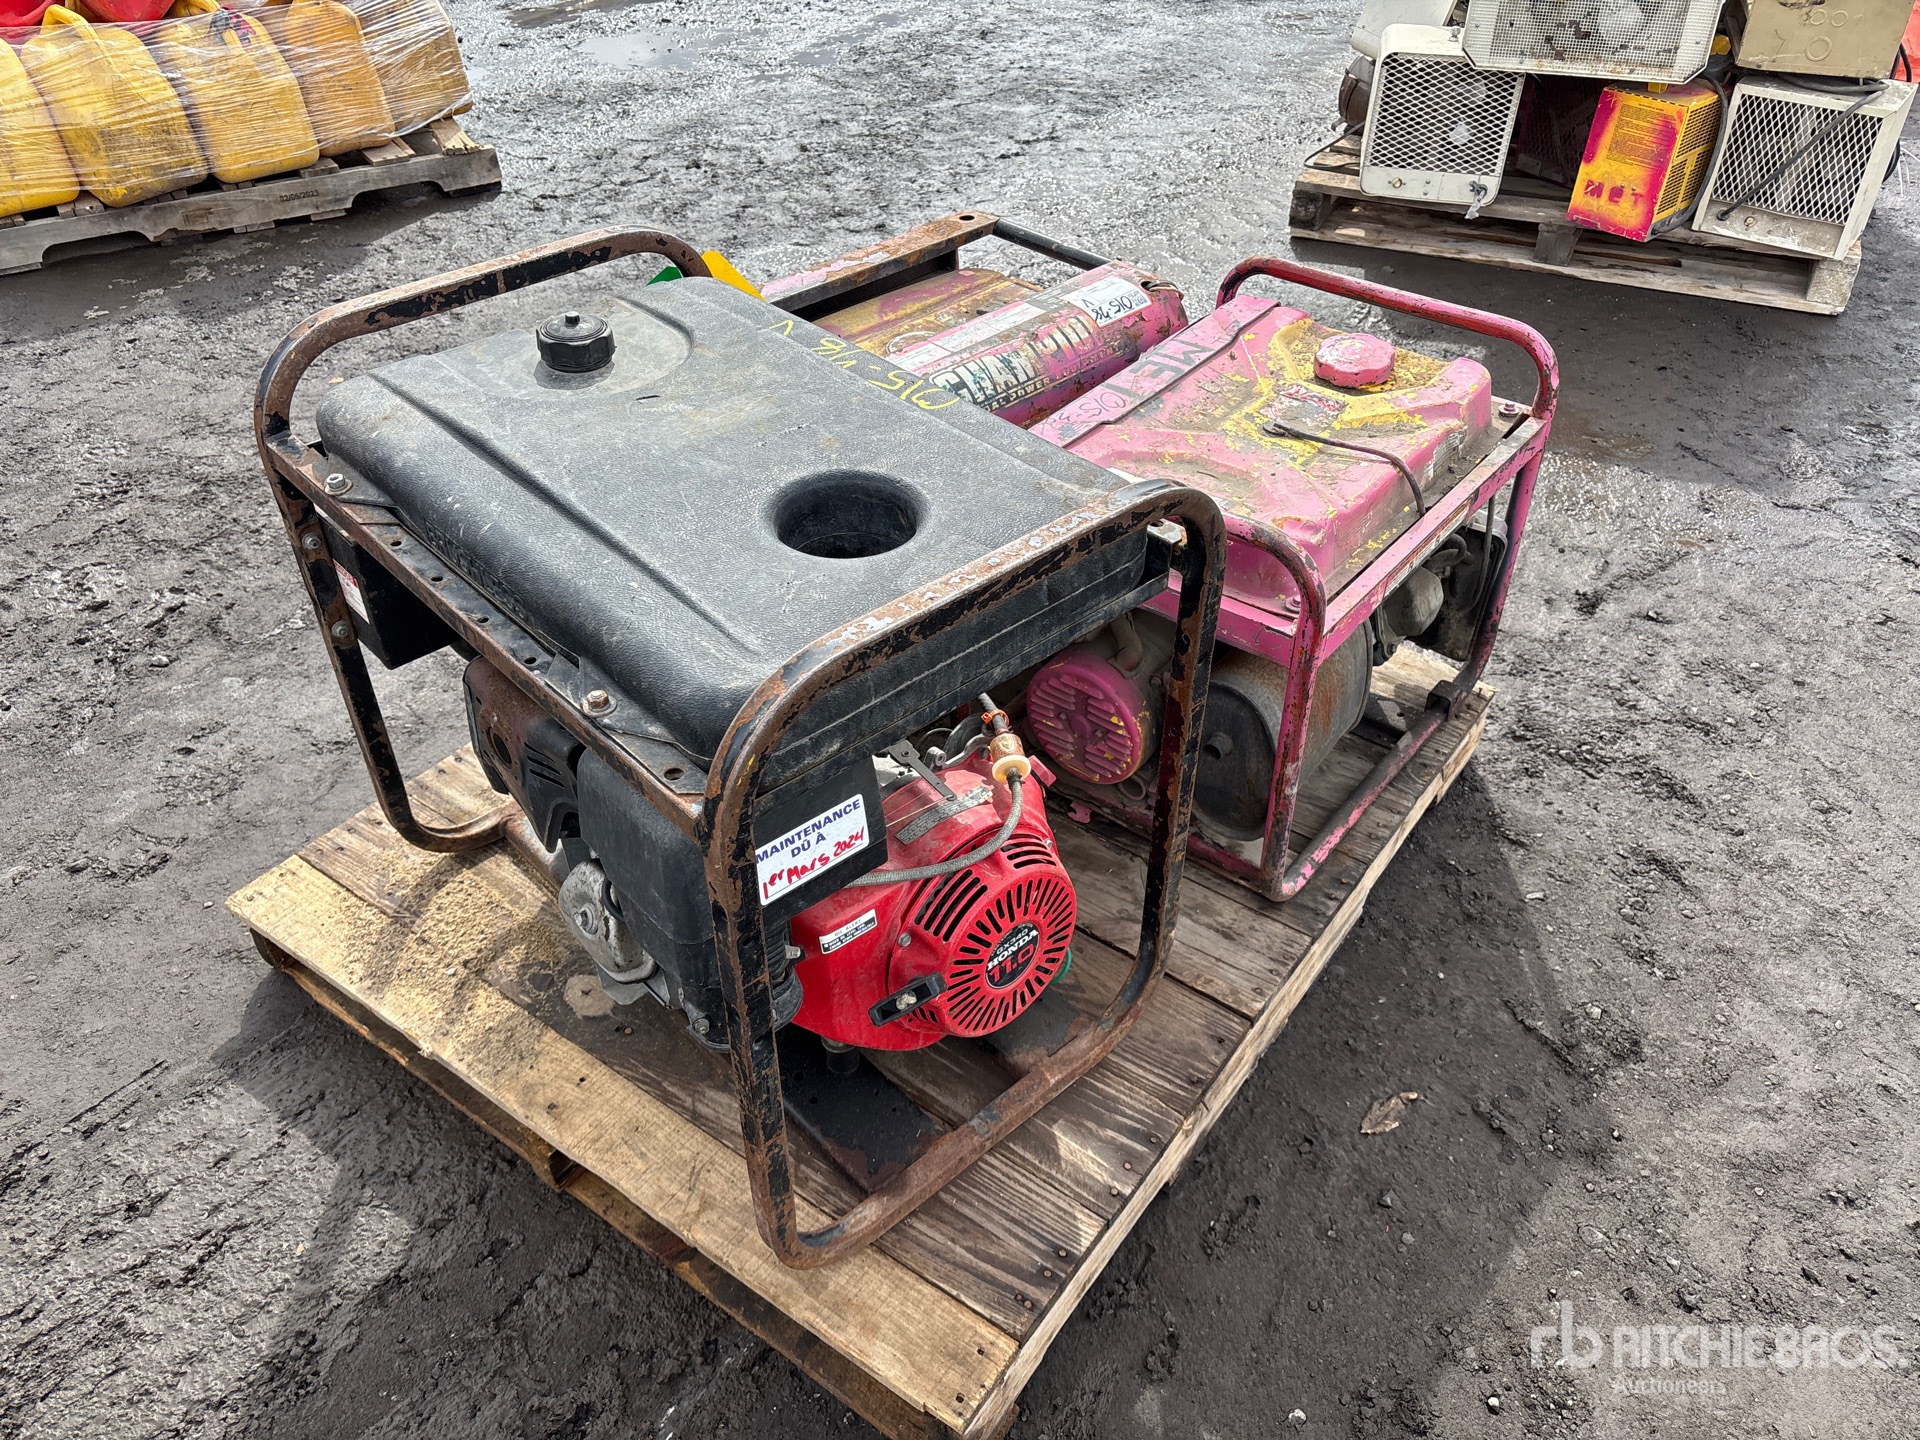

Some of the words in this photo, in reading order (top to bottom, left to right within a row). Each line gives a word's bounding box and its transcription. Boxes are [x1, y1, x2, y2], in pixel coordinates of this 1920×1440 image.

[1008, 377, 1051, 403] POWER
[755, 799, 861, 865] MAINTENANCE
[791, 839, 811, 859] DÛ
[815, 831, 827, 845] À
[763, 869, 785, 900] 1er
[833, 825, 865, 857] 2024
[987, 929, 1040, 971] HONDA
[996, 928, 1028, 955] GX340
[989, 943, 1035, 983] 11.0
